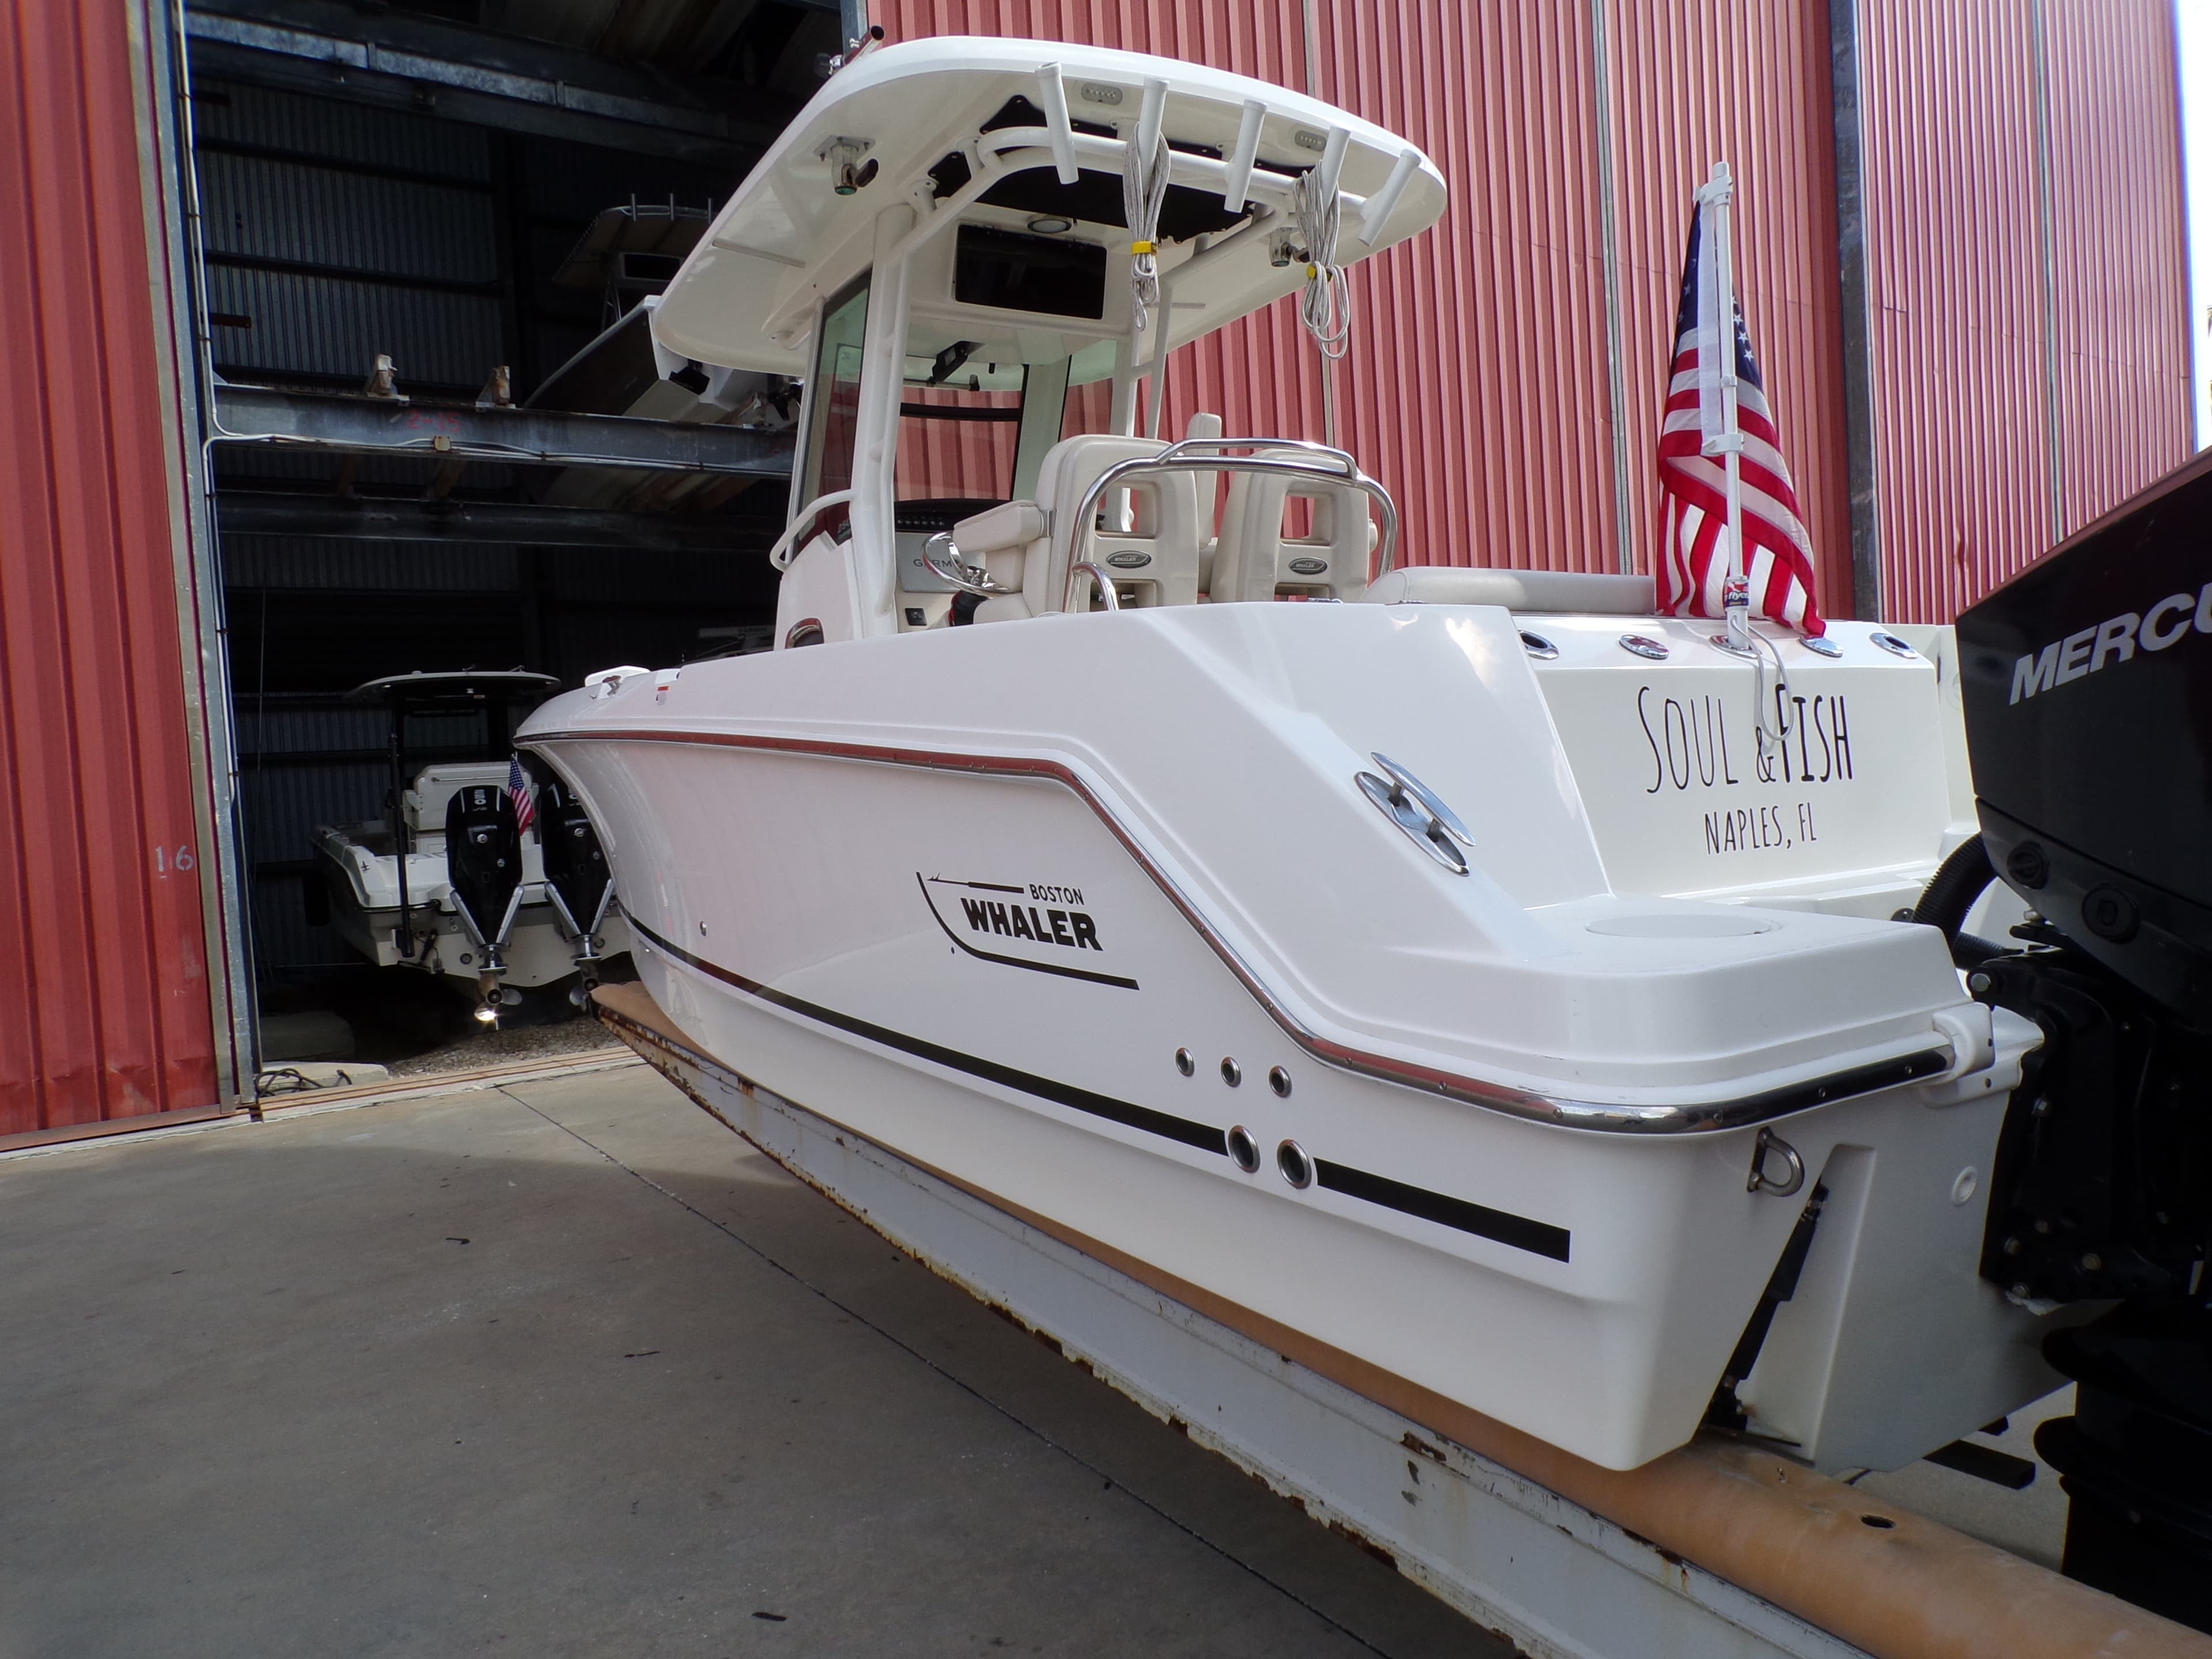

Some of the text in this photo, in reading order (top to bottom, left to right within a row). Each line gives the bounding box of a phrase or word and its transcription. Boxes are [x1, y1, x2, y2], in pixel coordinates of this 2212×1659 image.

[406, 409, 460, 432] 2-15
[1637, 683, 1853, 793] SOUL & FISH
[1704, 802, 1817, 855] NAPLES, FL
[156, 845, 194, 871] 16
[1029, 883, 1085, 906] BOSTON
[960, 897, 1104, 952] WHALER
